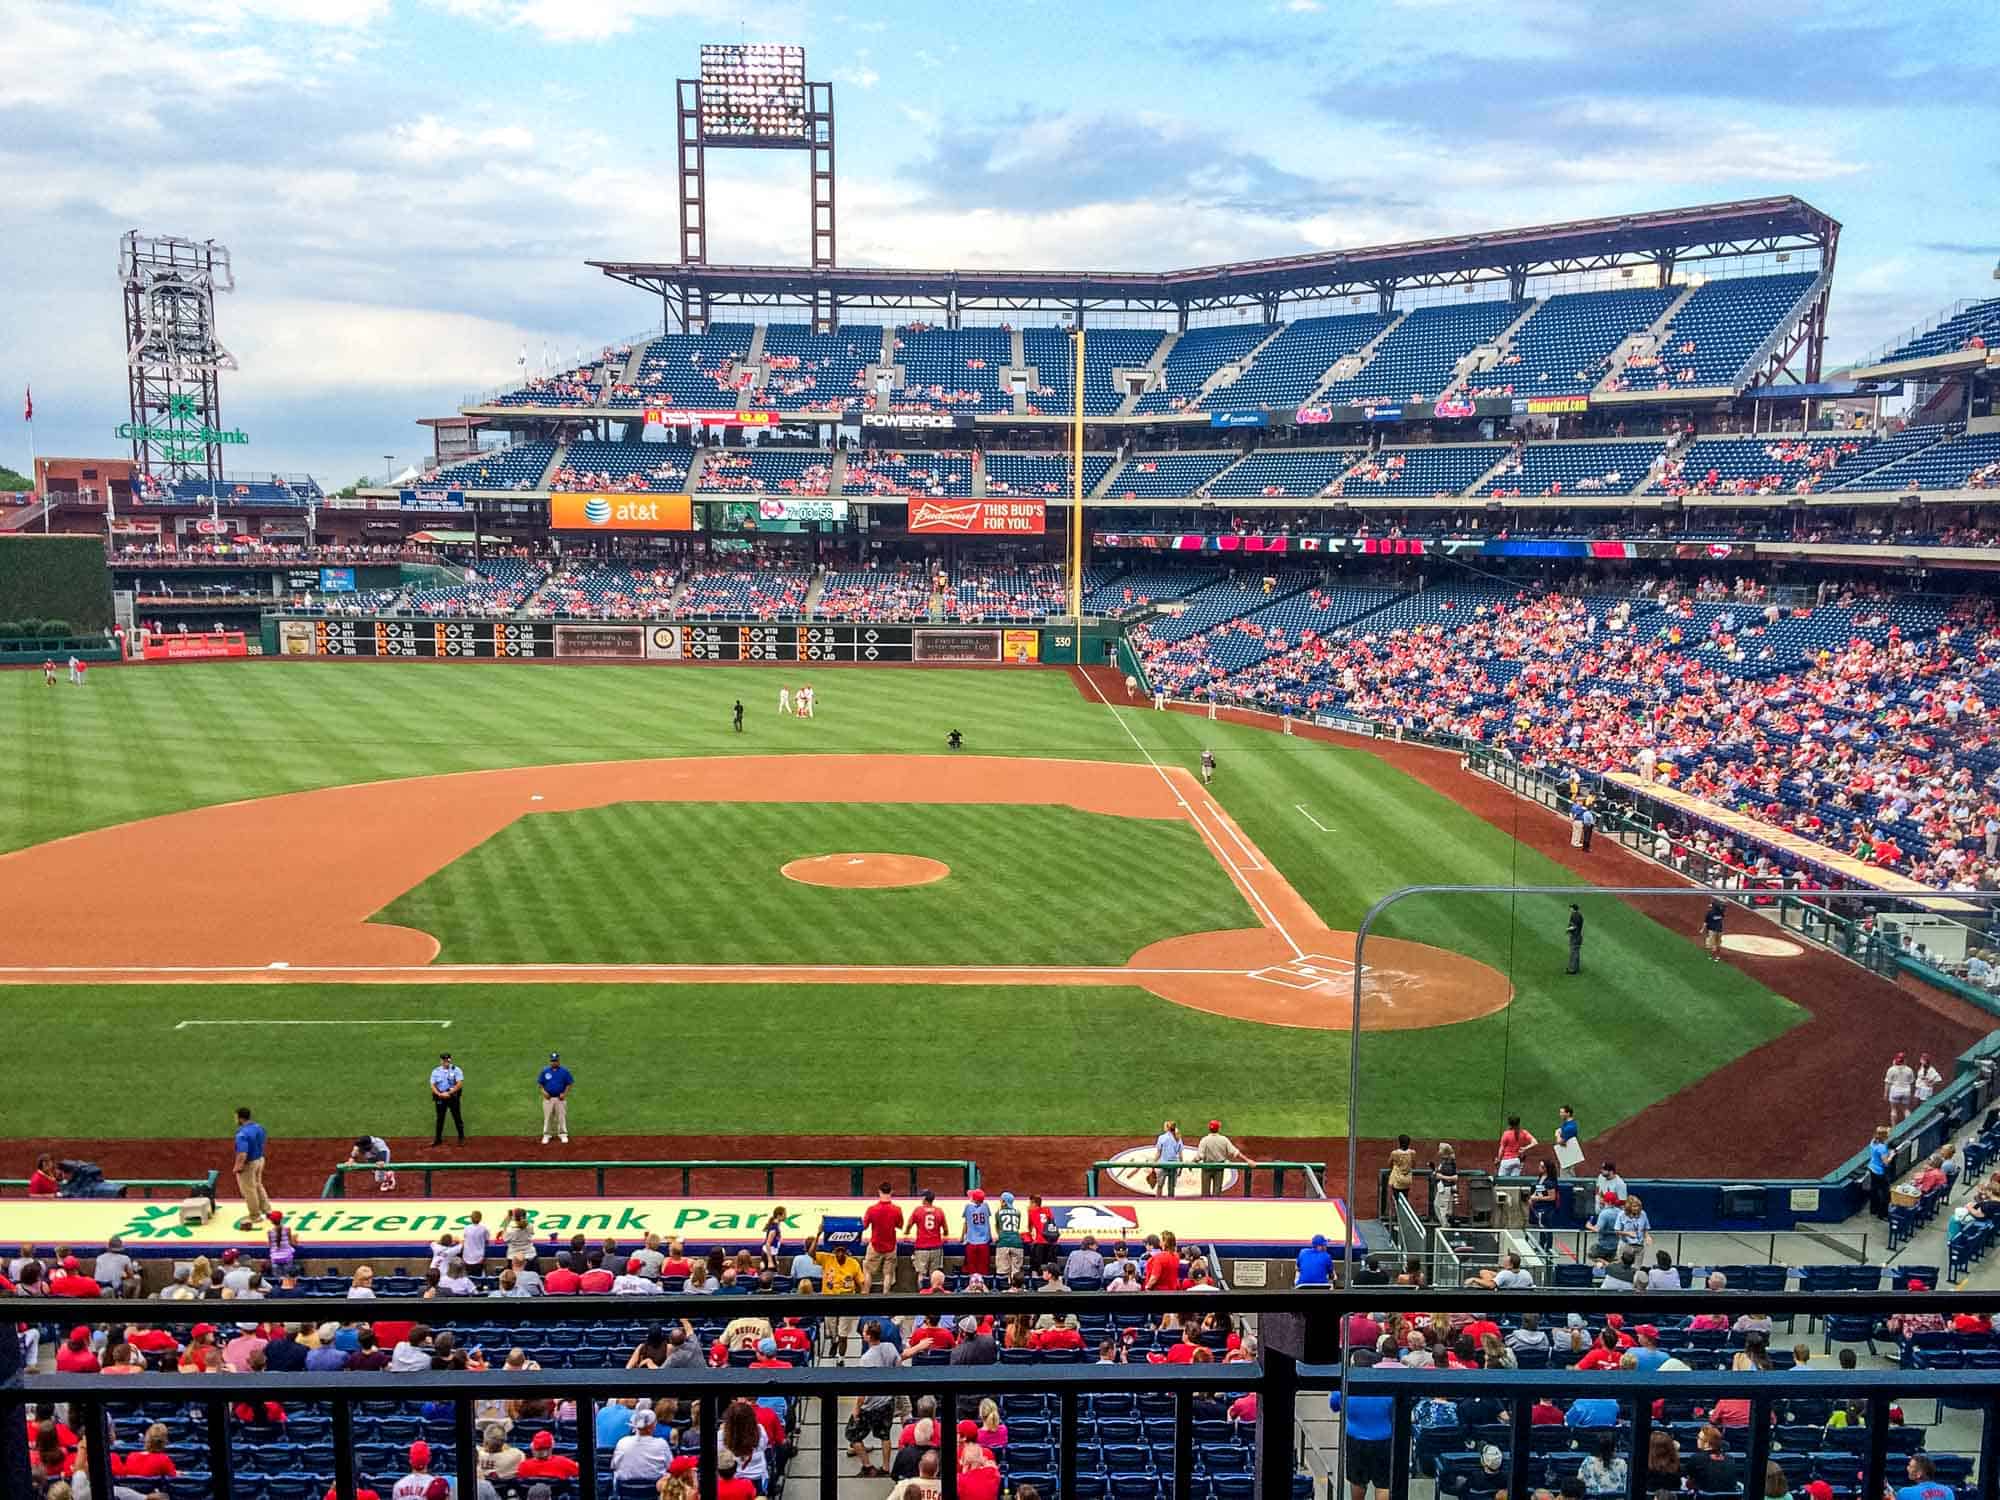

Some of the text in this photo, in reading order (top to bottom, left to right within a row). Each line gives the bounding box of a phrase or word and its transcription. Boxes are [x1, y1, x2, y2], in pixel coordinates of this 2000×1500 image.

[862, 415, 954, 428] POWERADE
[200, 426, 245, 445] Bank
[164, 446, 205, 461] Park
[983, 504, 1044, 516] THIS BUD'S
[983, 518, 1032, 529] FOR YOU.
[924, 1214, 935, 1230] 6
